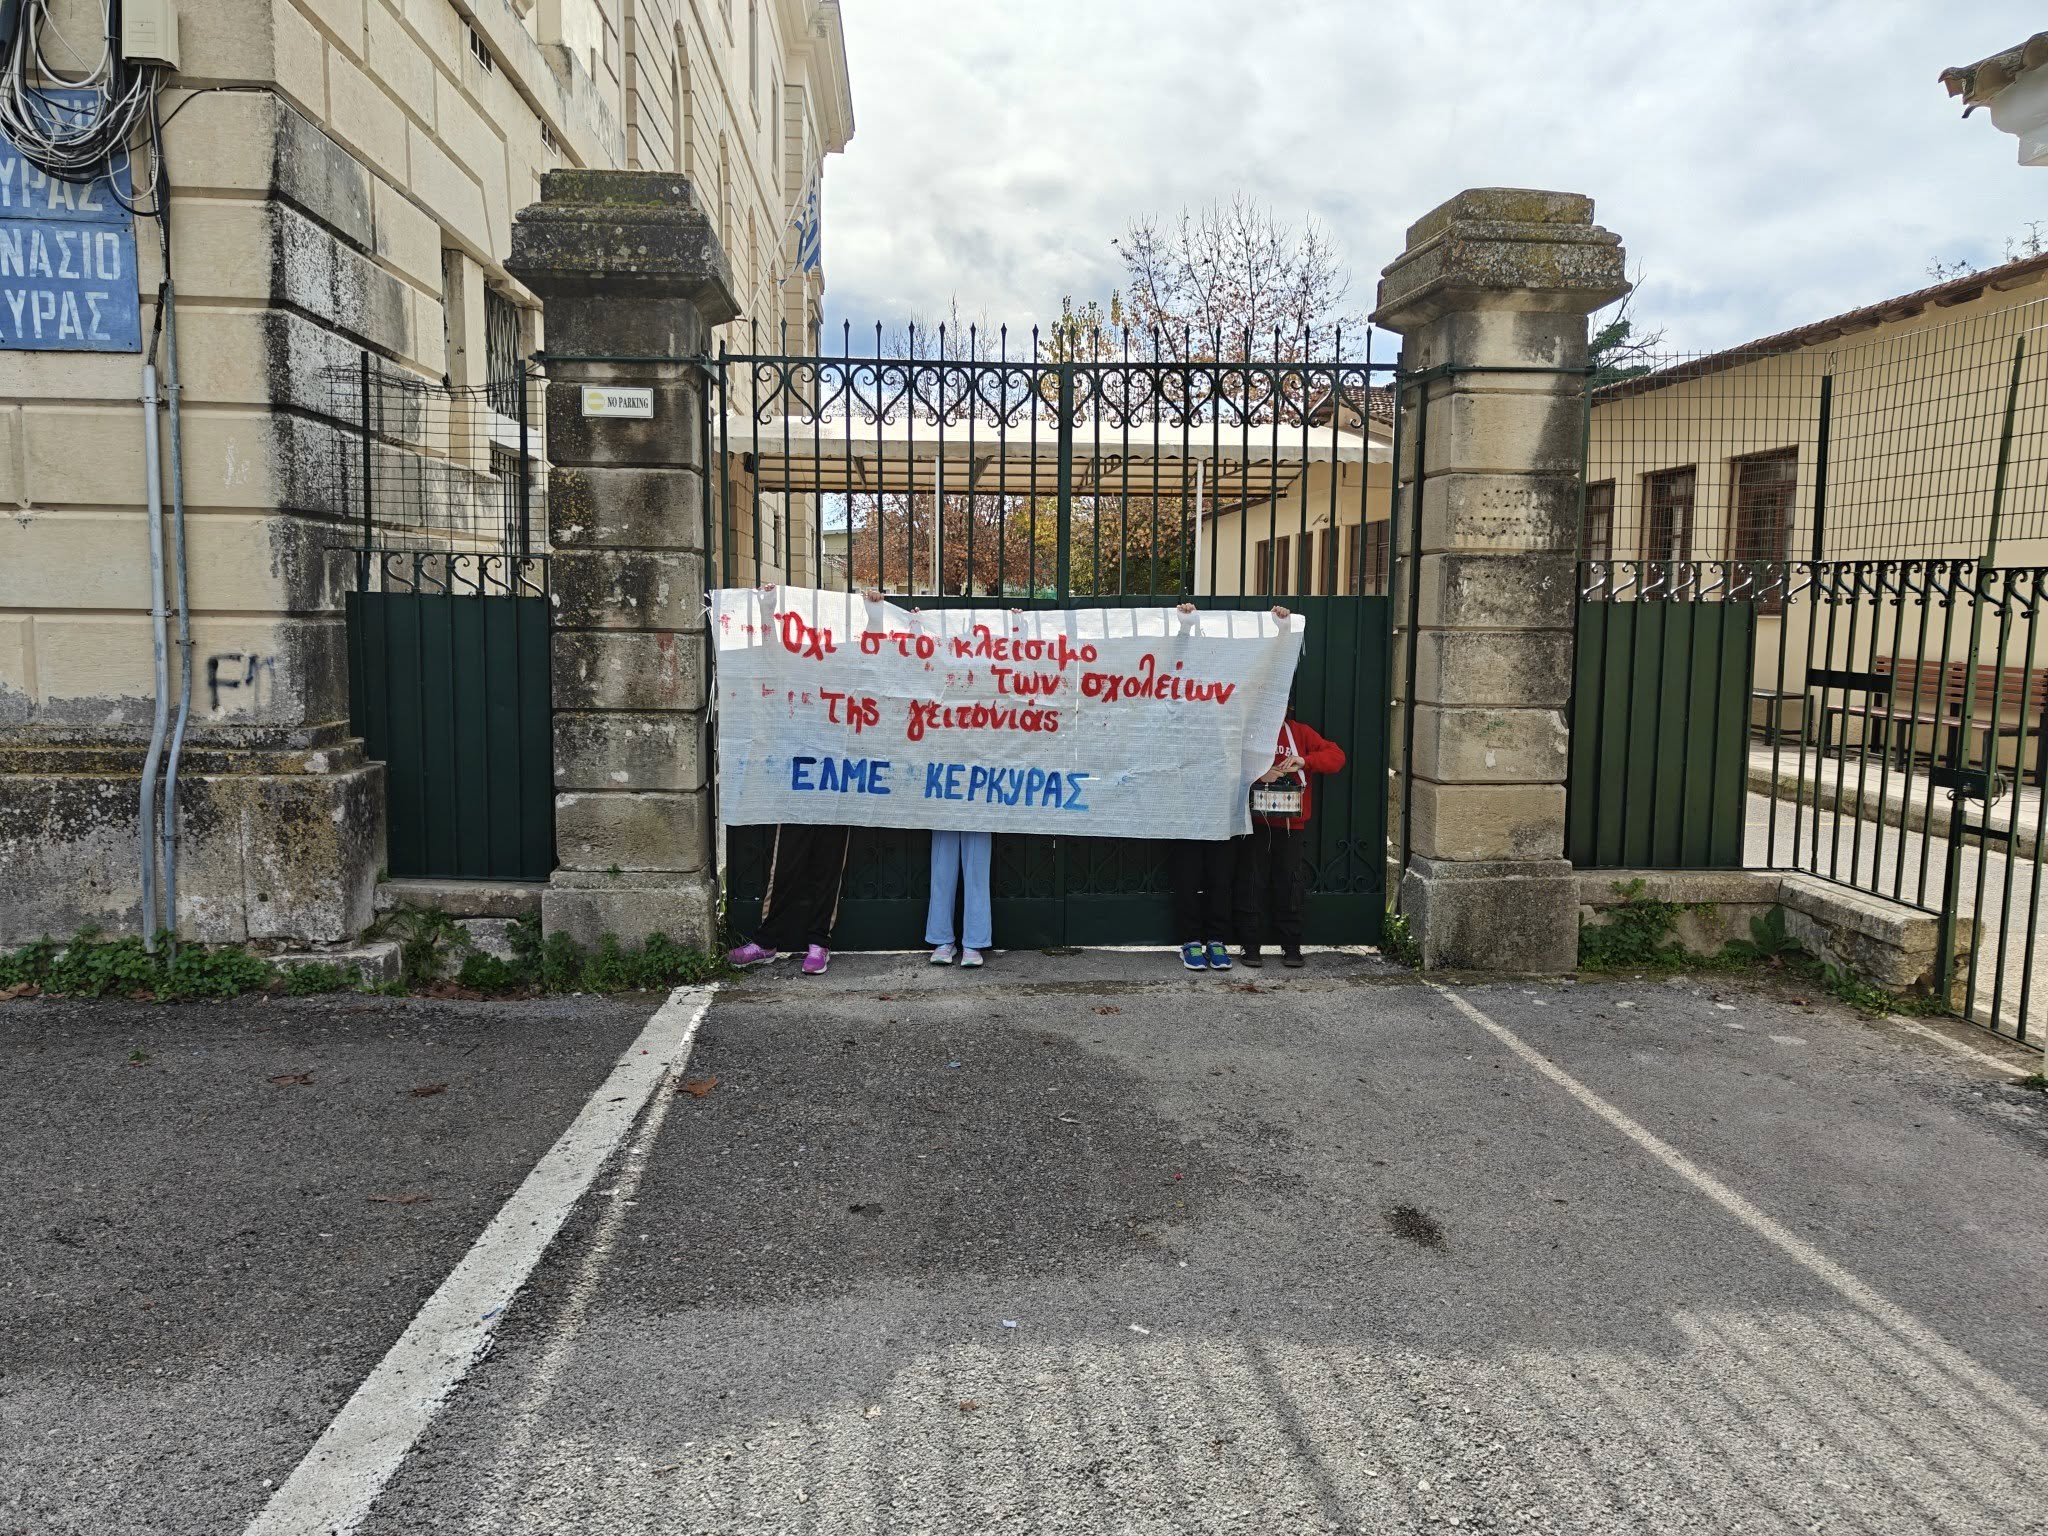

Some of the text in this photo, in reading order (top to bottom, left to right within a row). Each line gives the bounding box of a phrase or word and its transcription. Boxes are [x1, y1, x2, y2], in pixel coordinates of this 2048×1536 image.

[0, 289, 111, 340] ΥΡΑΣ
[607, 396, 649, 409] NO PARKING
[860, 630, 935, 659] στο
[954, 624, 1098, 671] κλείσιμο
[991, 653, 1236, 705] των σχολείων
[820, 687, 1060, 742] της γειτονιάς
[792, 757, 1090, 811] ΕΛΜΕ ΚΕΡΚΥΡΑΣ
